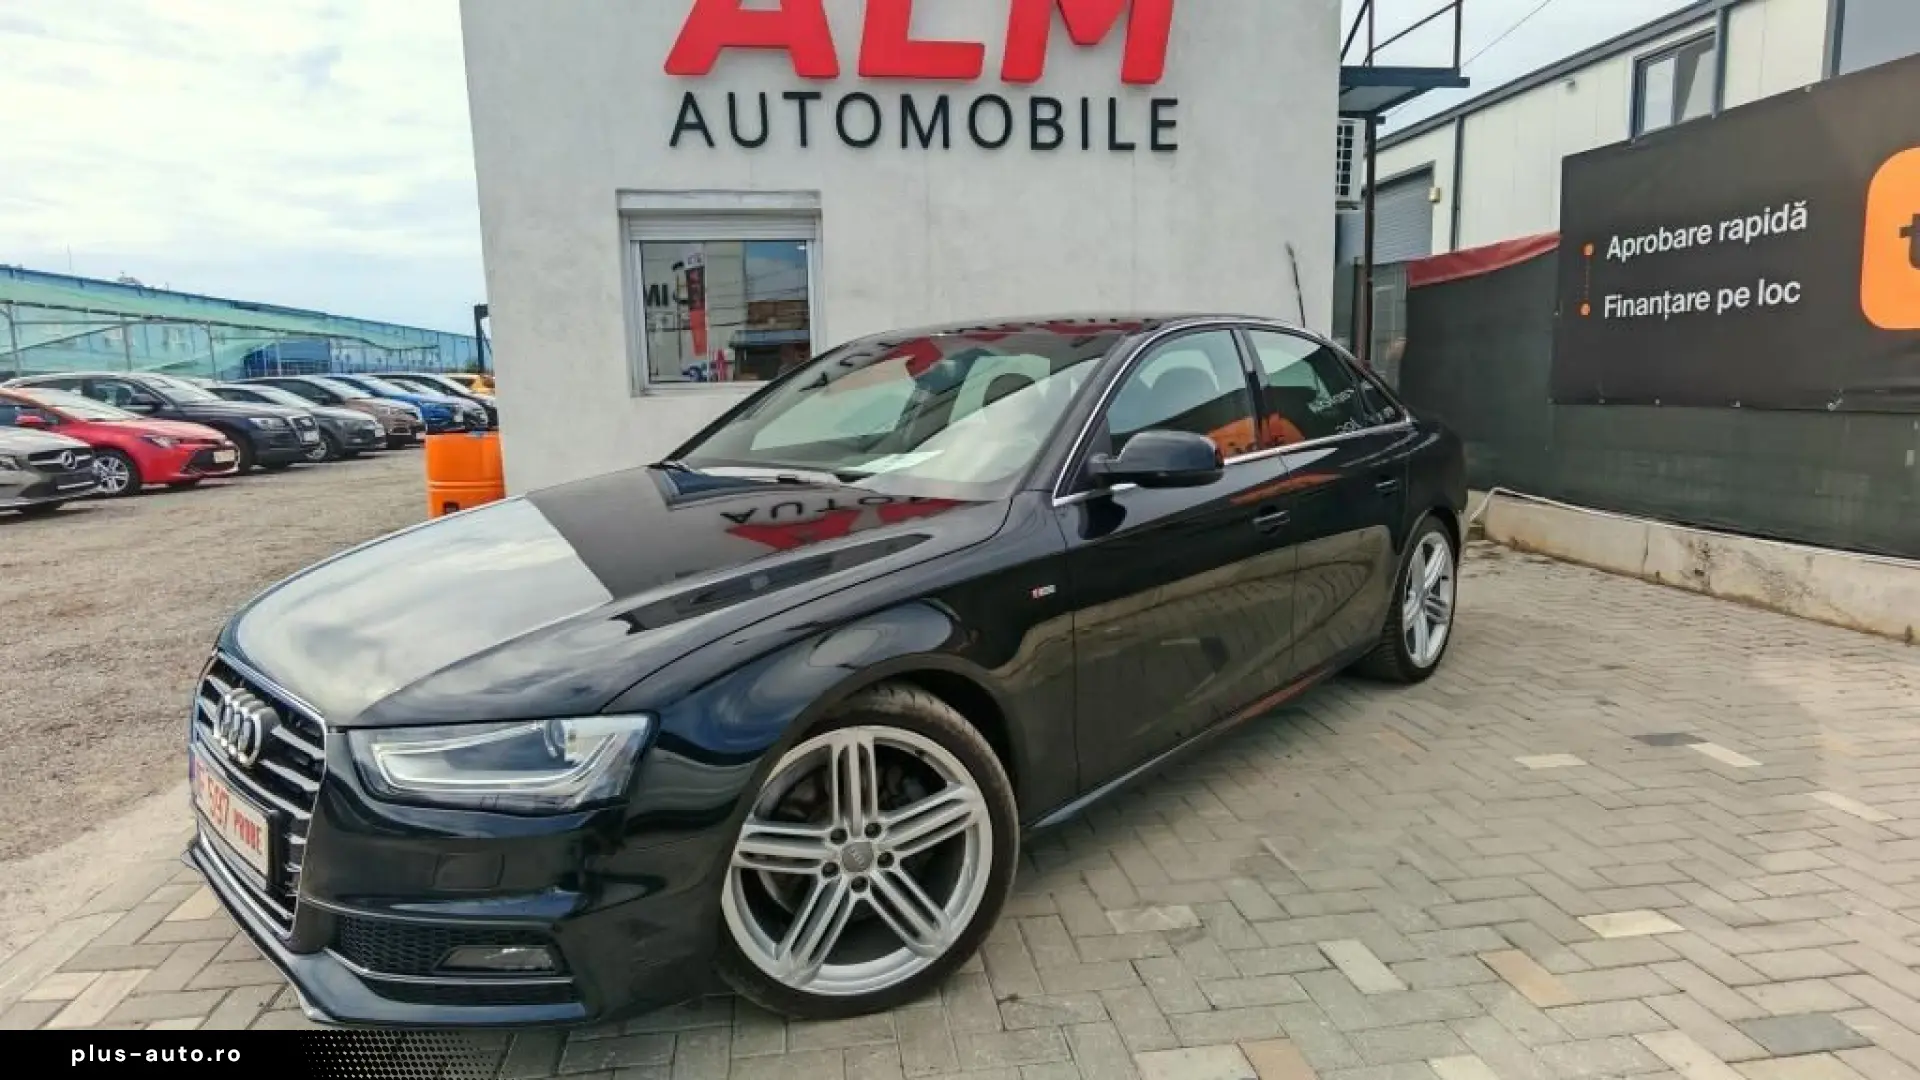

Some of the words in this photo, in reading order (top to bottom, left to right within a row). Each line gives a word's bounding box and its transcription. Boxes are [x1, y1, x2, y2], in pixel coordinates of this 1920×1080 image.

[664, 0, 1175, 84] ALM
[669, 92, 1179, 152] AUTOMOBILE
[1606, 224, 1711, 263] Aprobare
[1719, 200, 1808, 245] rapidă
[1604, 289, 1710, 320] Finanțare
[1717, 283, 1750, 314] pe
[1758, 278, 1801, 306] loc
